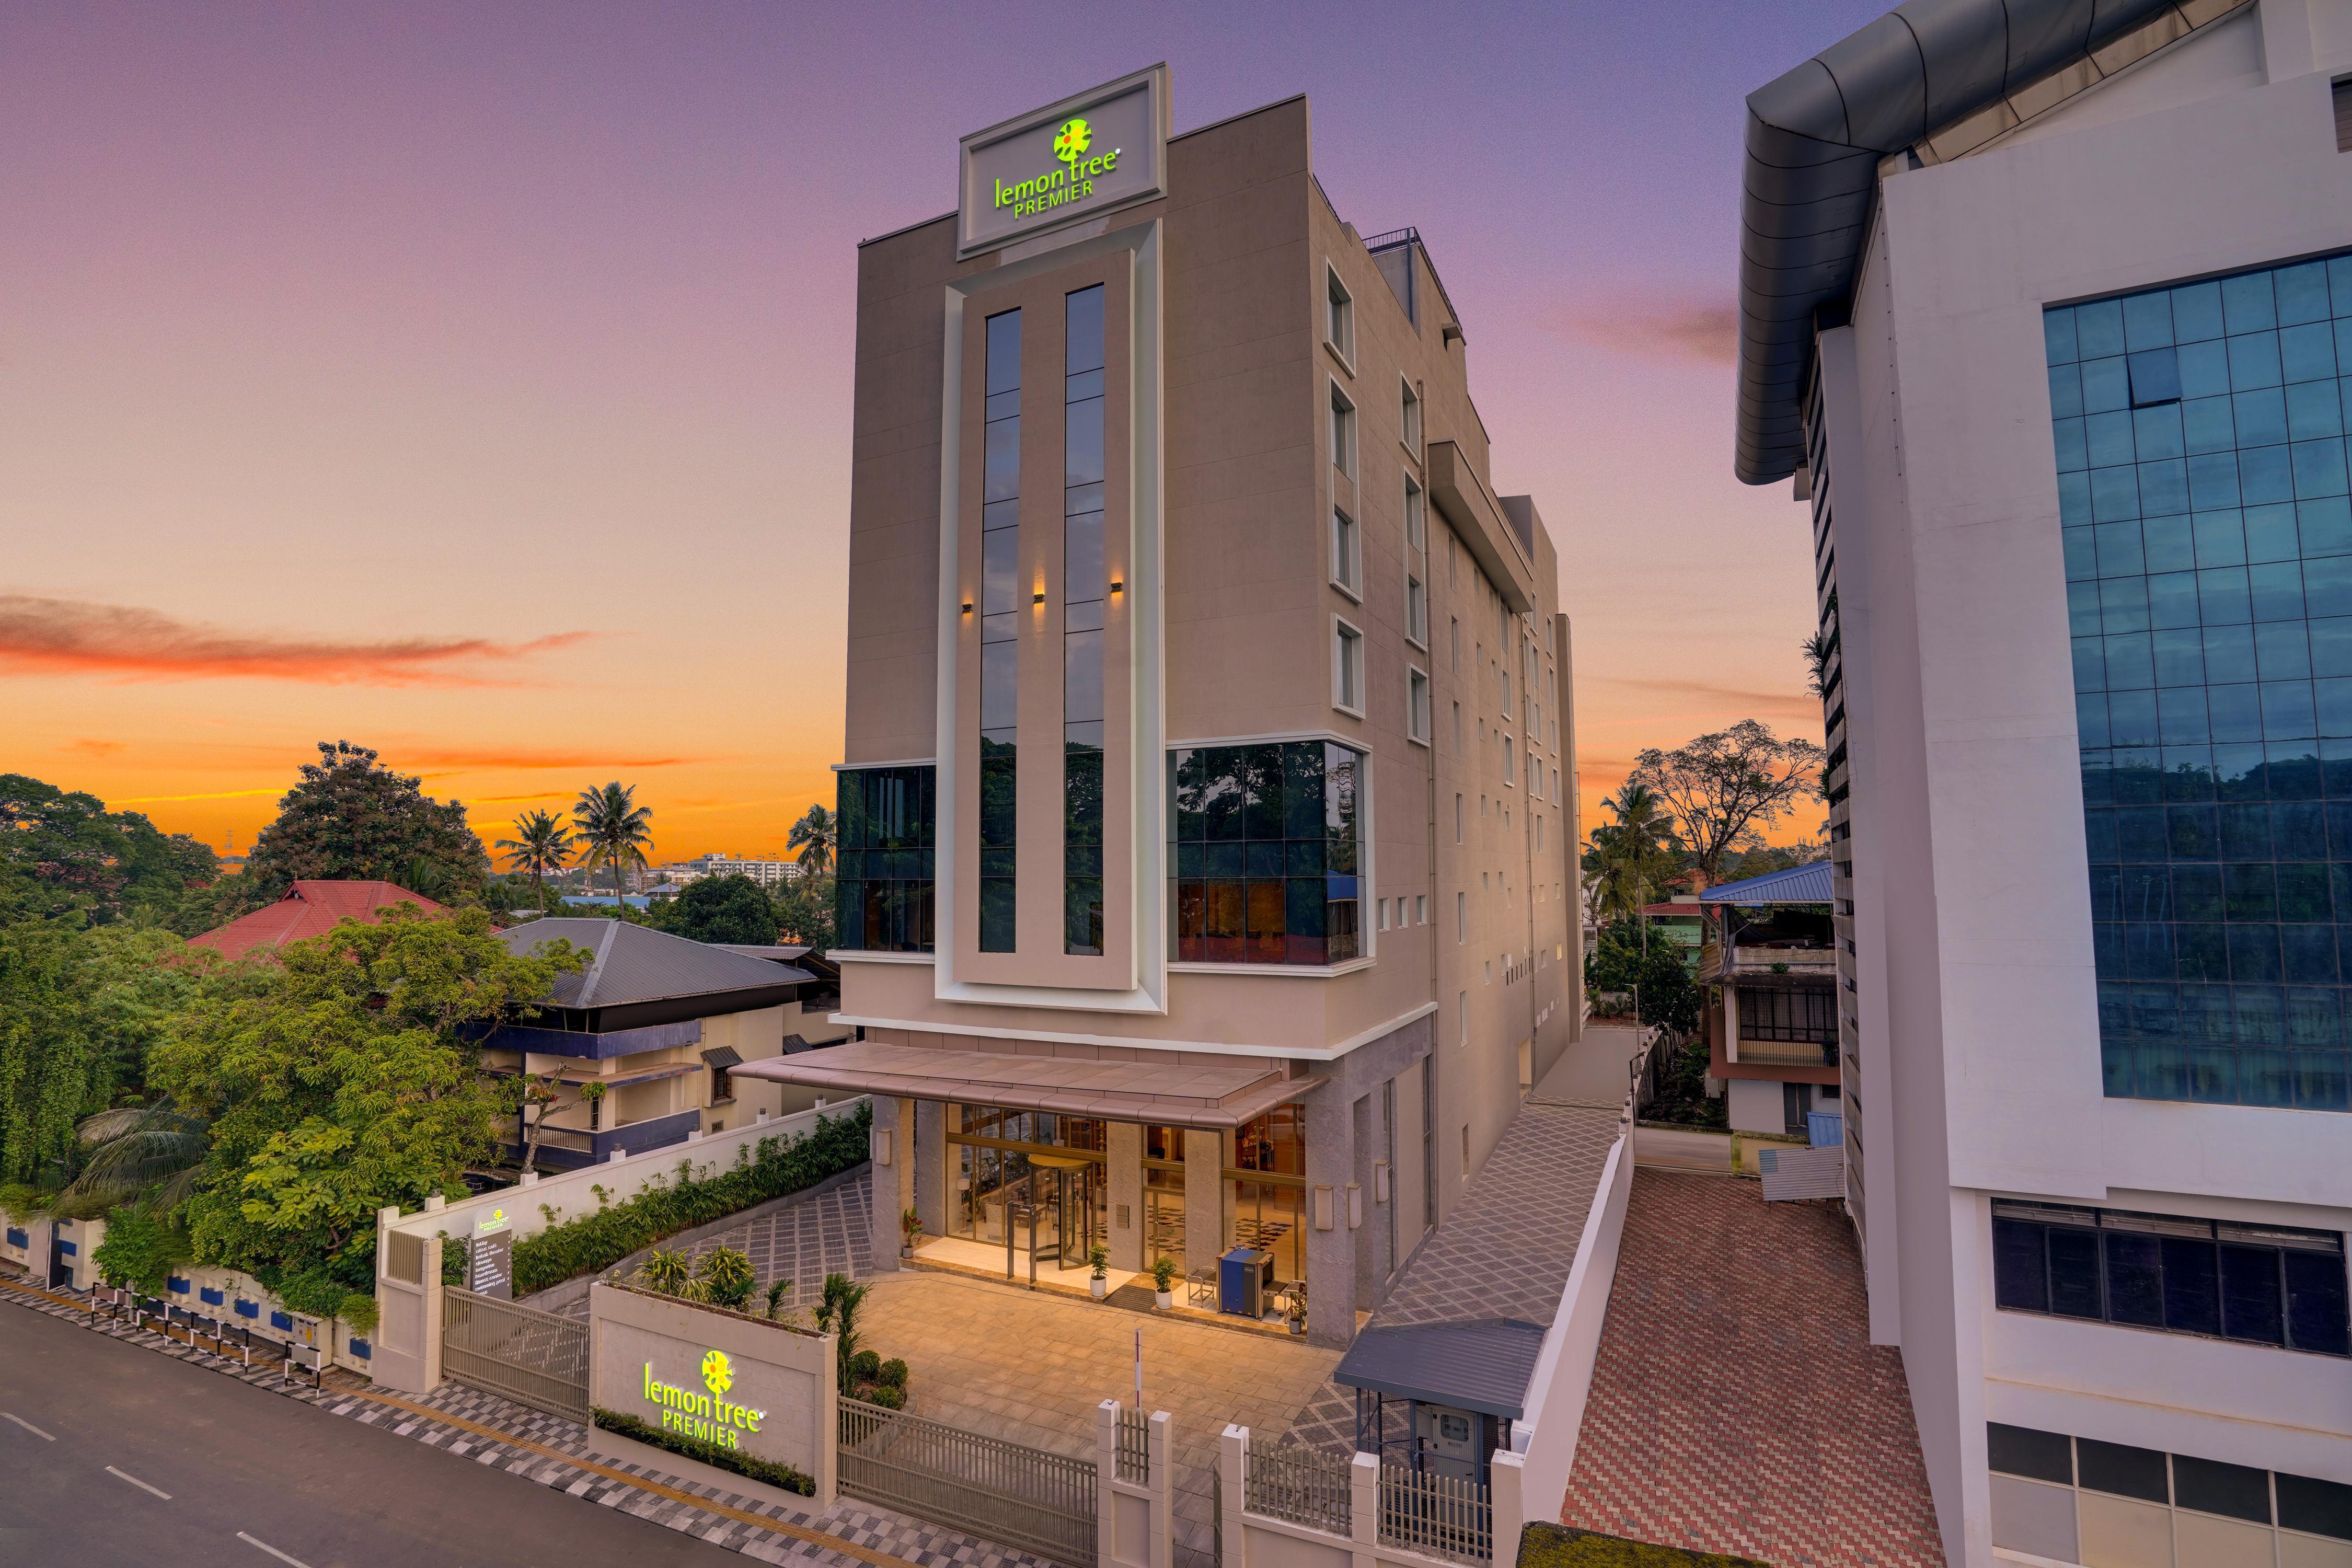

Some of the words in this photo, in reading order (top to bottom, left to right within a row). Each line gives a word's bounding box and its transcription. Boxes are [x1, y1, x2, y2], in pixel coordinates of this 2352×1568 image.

[995, 169, 1064, 208] lemon
[1068, 152, 1116, 182] tree
[1014, 180, 1092, 219] PREMIER
[479, 1220, 497, 1229] lemon
[484, 1223, 503, 1231] PREMIER
[475, 1269, 498, 1278] boardroom
[475, 1282, 495, 1292] swimming
[644, 1363, 709, 1419] lemon
[713, 1392, 762, 1433] tree
[663, 1409, 737, 1450] PREMIER
